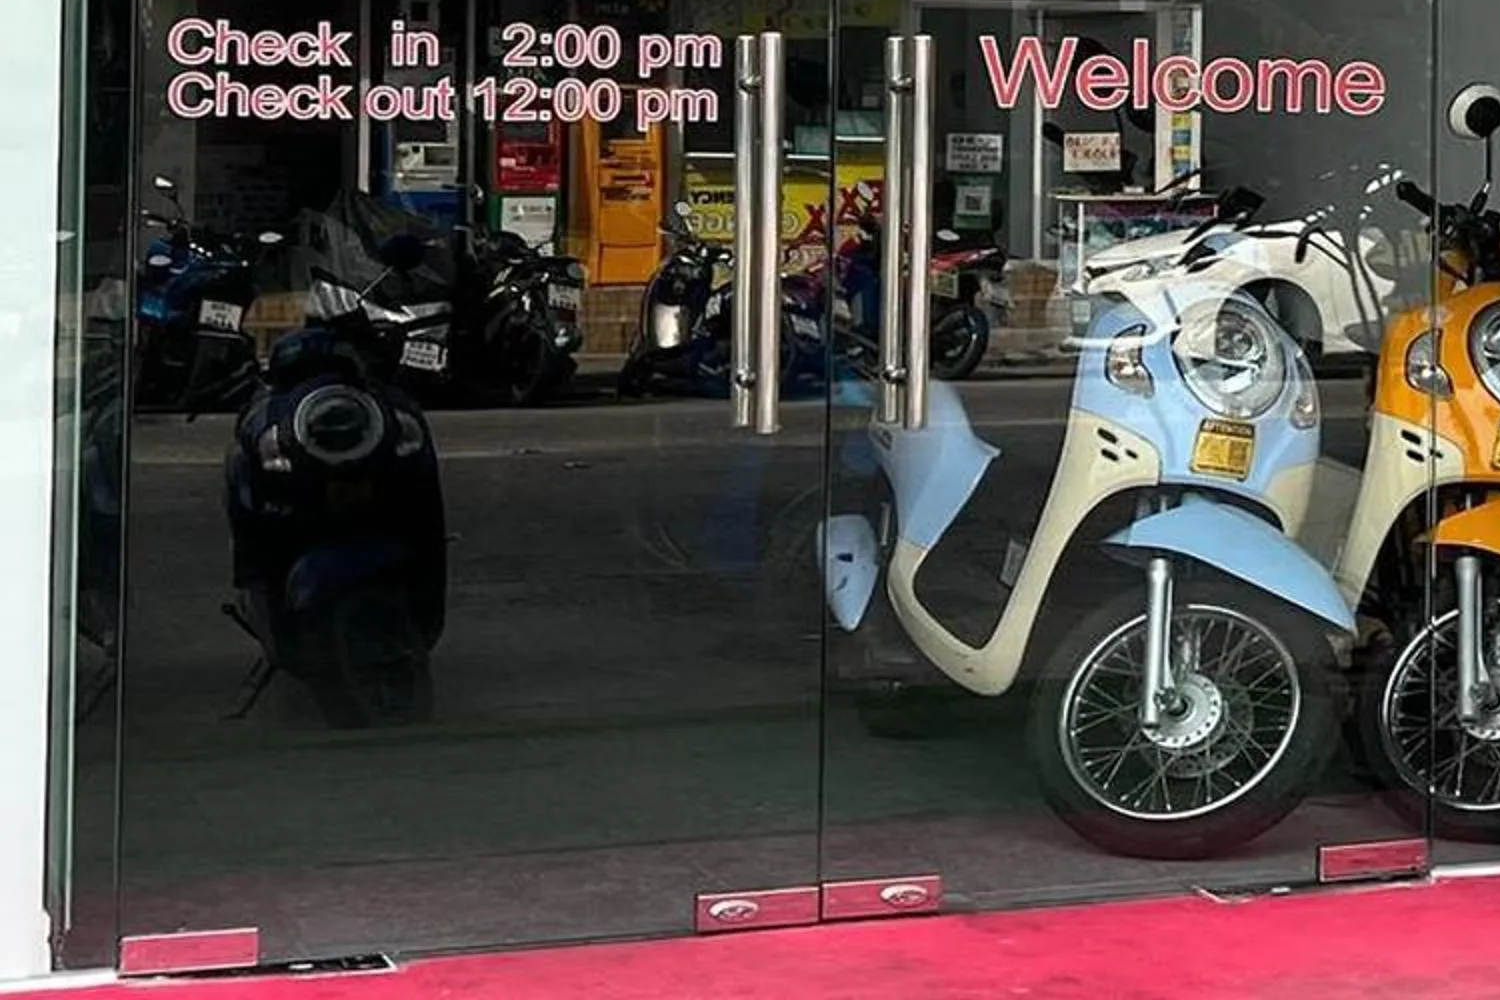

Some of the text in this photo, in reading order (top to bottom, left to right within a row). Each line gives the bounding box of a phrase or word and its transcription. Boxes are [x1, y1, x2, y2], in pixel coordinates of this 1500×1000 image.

[167, 19, 722, 78] Check in 2:00 pm
[979, 35, 1386, 116] Welcome
[167, 72, 719, 132] Check out 12:00 pm
